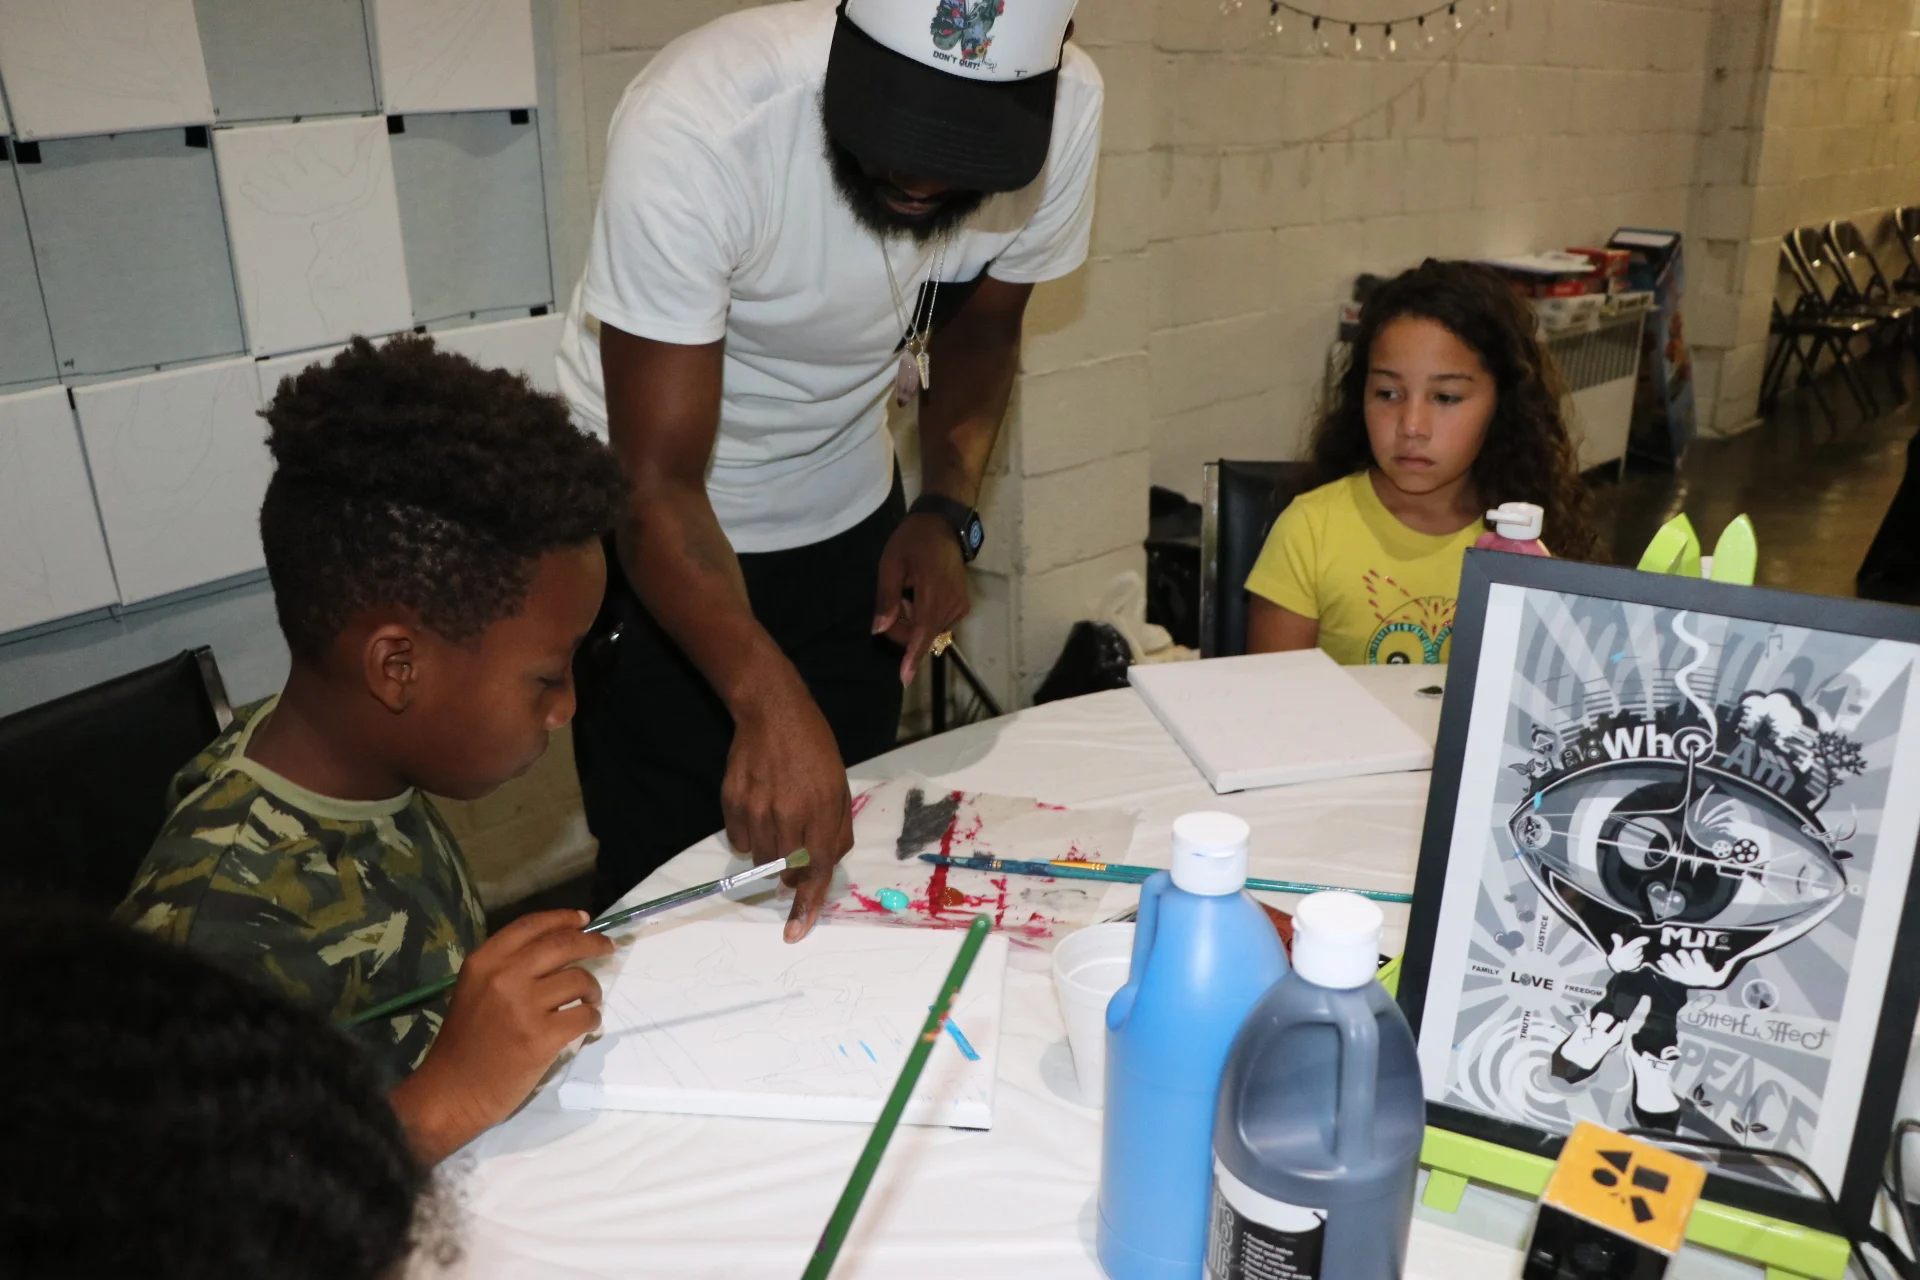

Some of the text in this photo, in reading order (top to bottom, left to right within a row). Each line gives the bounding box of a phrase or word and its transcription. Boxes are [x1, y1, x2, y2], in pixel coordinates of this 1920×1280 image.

[932, 50, 958, 63] DON'T
[958, 59, 981, 71] QUIT!
[1602, 724, 1796, 796] Who Am
[1537, 915, 1549, 952] JUSTICE
[1471, 964, 1500, 976] FAMILY
[1510, 971, 1554, 991] LOVE
[1564, 984, 1603, 997] FREEDOM
[1520, 1010, 1531, 1039] TRUTH
[1669, 1038, 1819, 1152] PEACE
